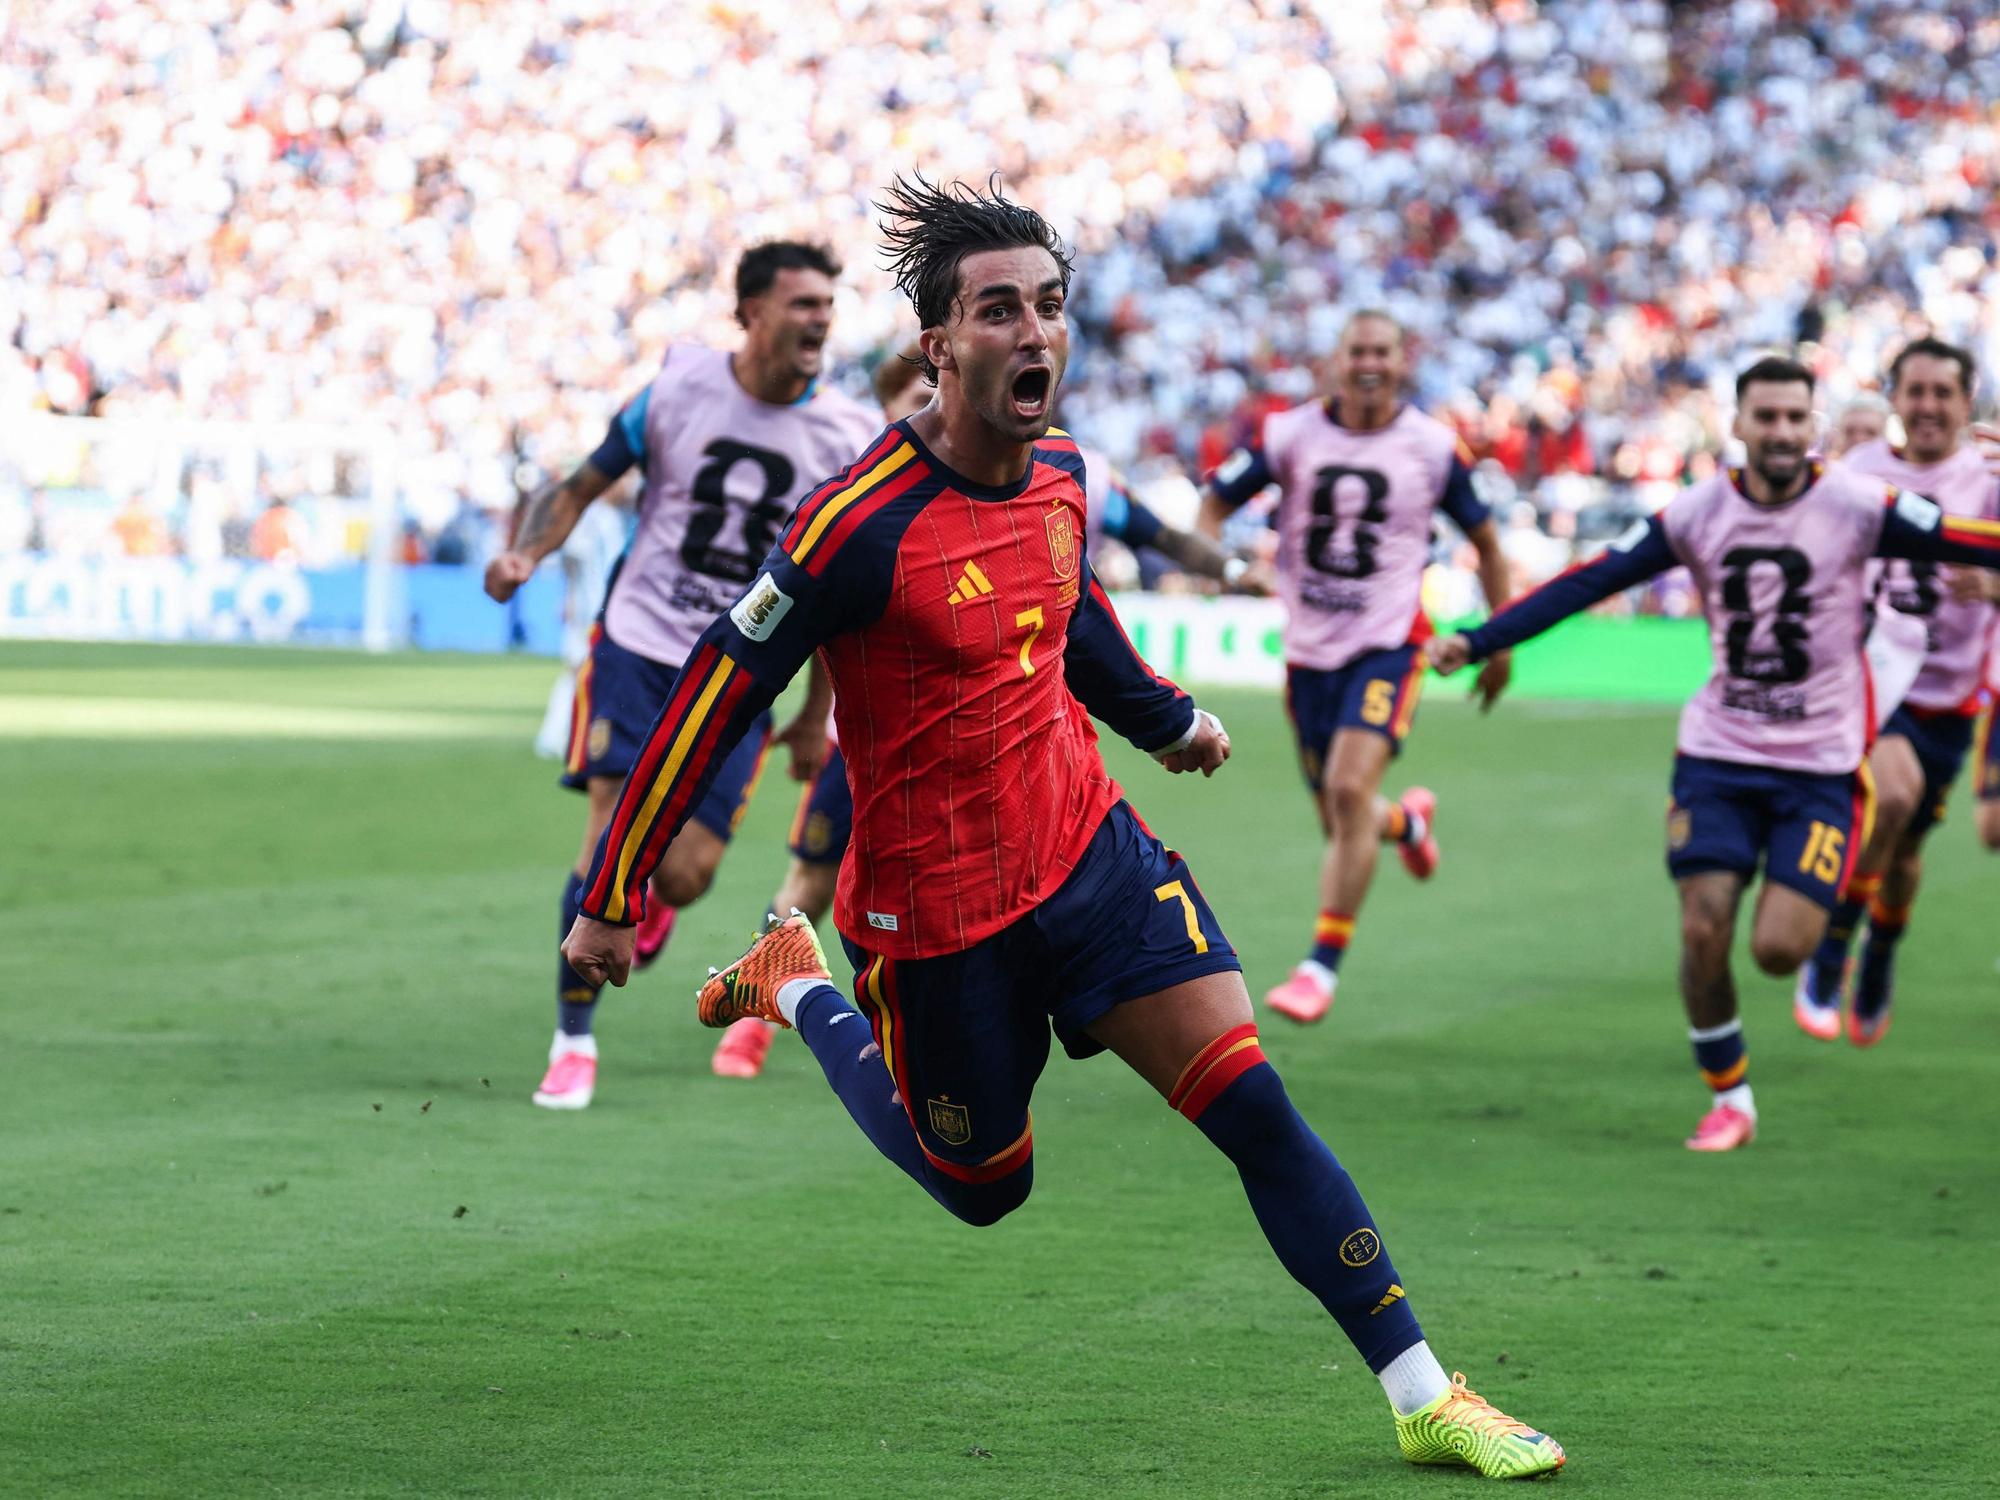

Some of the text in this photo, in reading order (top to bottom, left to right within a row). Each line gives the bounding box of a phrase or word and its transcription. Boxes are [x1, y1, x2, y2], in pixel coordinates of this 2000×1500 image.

[737, 616, 758, 636] 2026
[1015, 605, 1044, 679] 7
[1361, 679, 1396, 725] 5
[1798, 819, 1845, 885] 15
[1153, 879, 1209, 954] 7
